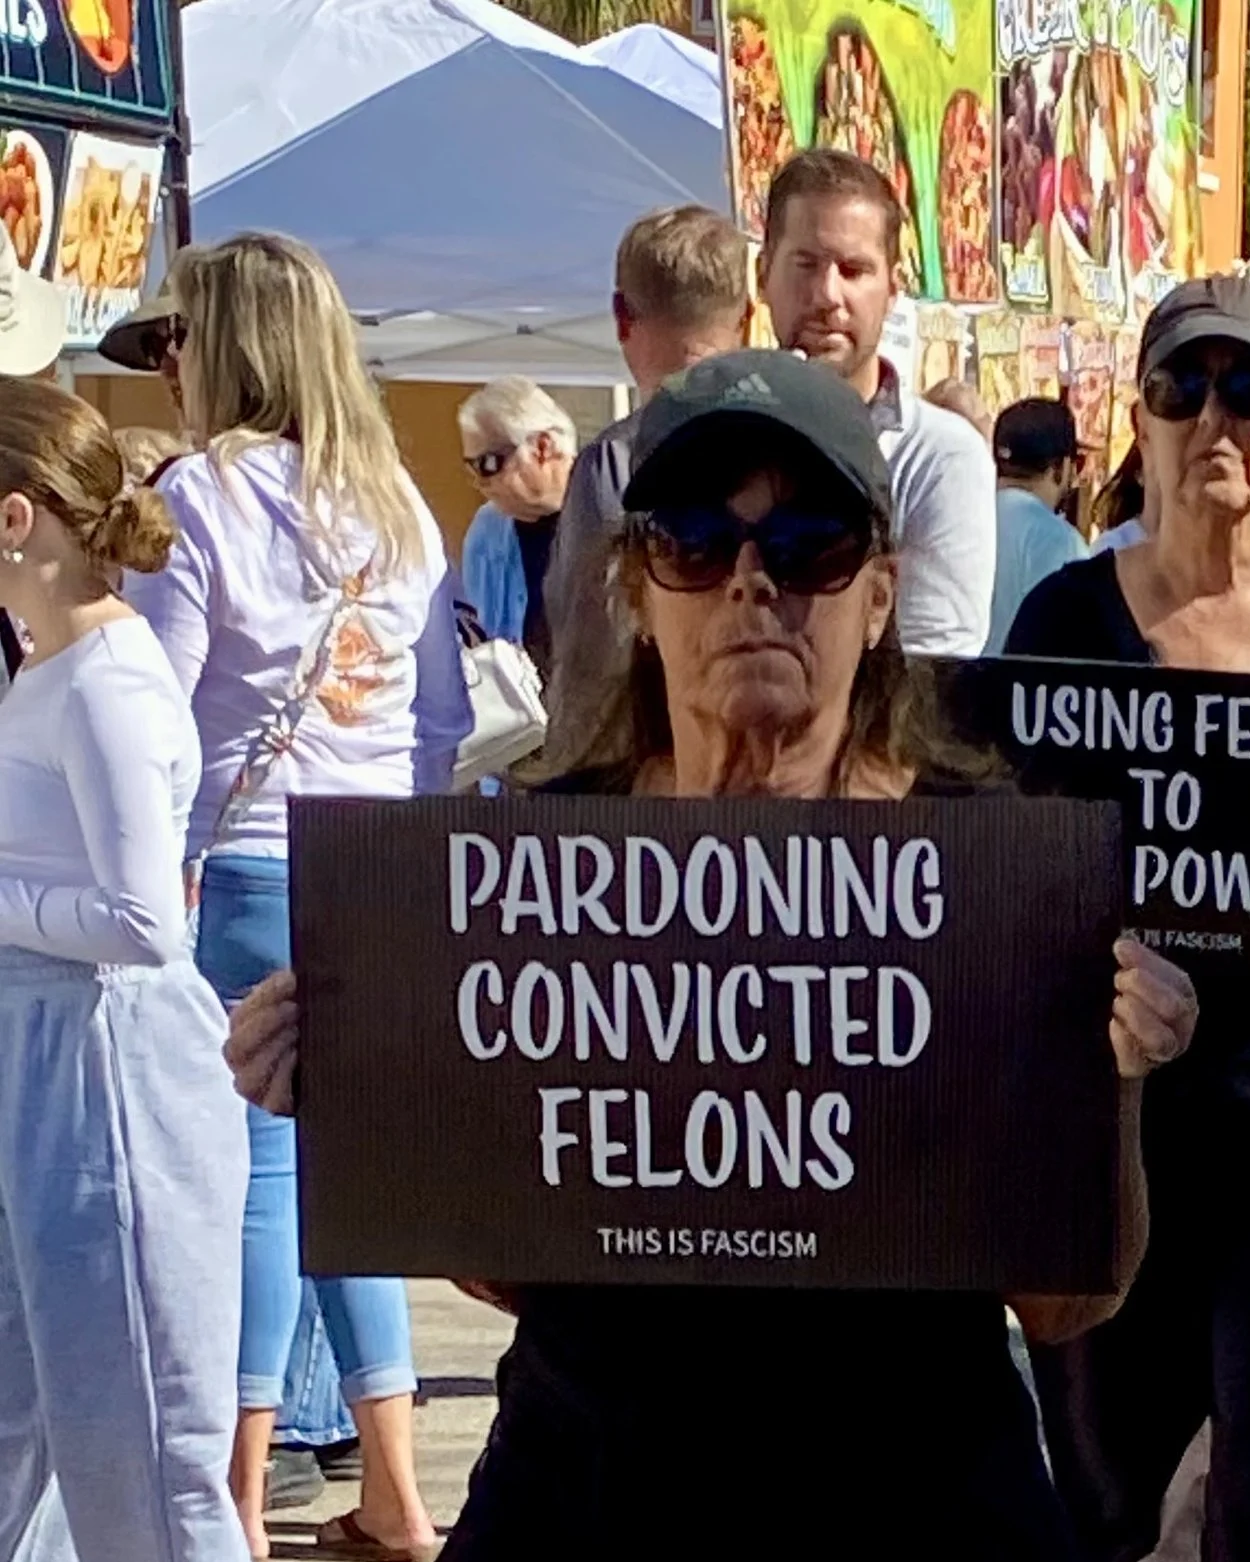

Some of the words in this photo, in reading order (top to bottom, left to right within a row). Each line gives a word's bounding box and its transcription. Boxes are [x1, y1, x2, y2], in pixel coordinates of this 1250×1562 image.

[1013, 683, 1173, 752] USING
[1129, 769, 1200, 830] TO
[450, 834, 942, 937] PARDONING
[459, 962, 930, 1065] CONVICTED
[539, 1089, 853, 1189] FELONS
[597, 1227, 663, 1257] THIS
[668, 1227, 695, 1257] IS
[700, 1227, 818, 1260] FASCISM
